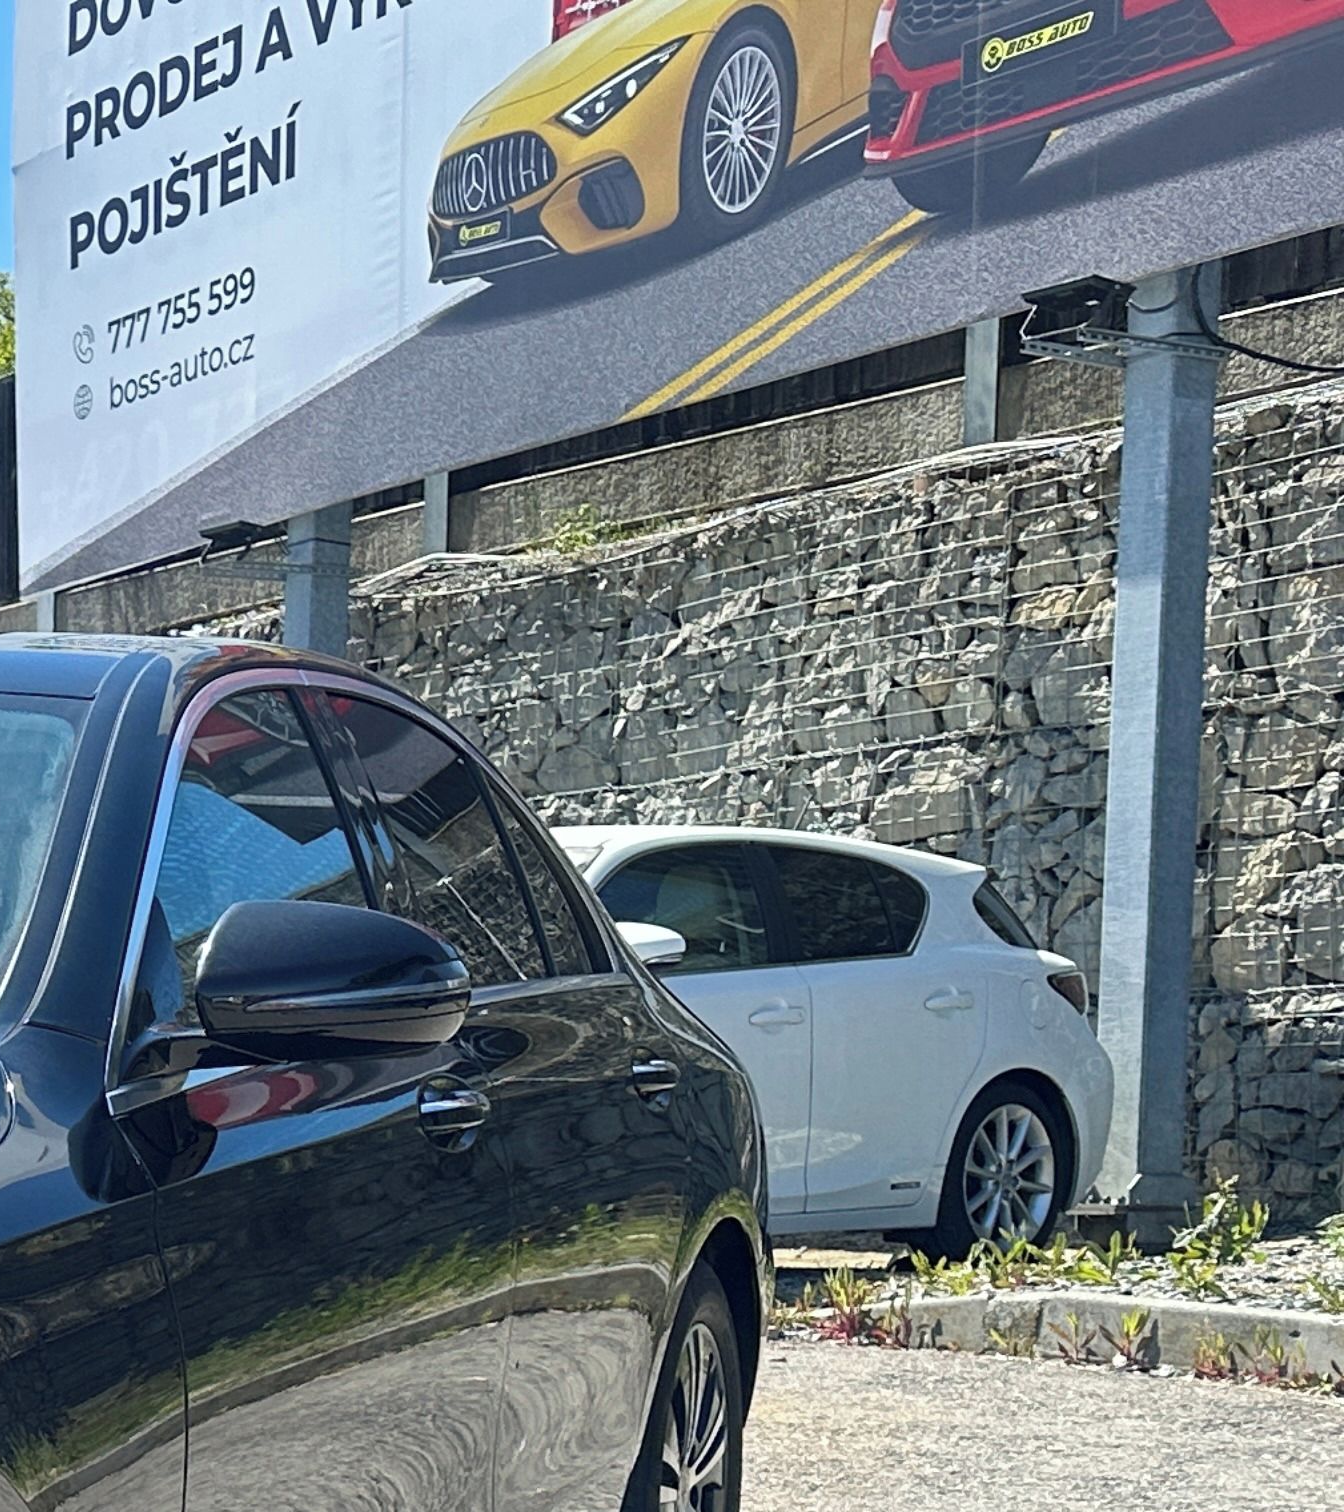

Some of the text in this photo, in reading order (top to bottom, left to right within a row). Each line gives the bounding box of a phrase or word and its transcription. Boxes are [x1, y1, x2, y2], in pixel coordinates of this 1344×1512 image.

[66, 24, 243, 160] PRODEJ
[255, 6, 293, 73] A
[1006, 32, 1044, 56] BOSS
[70, 100, 303, 270] POJIŠTĚNÍ
[107, 267, 256, 354] 777 755 599
[110, 333, 255, 410] boss-auto.cz
